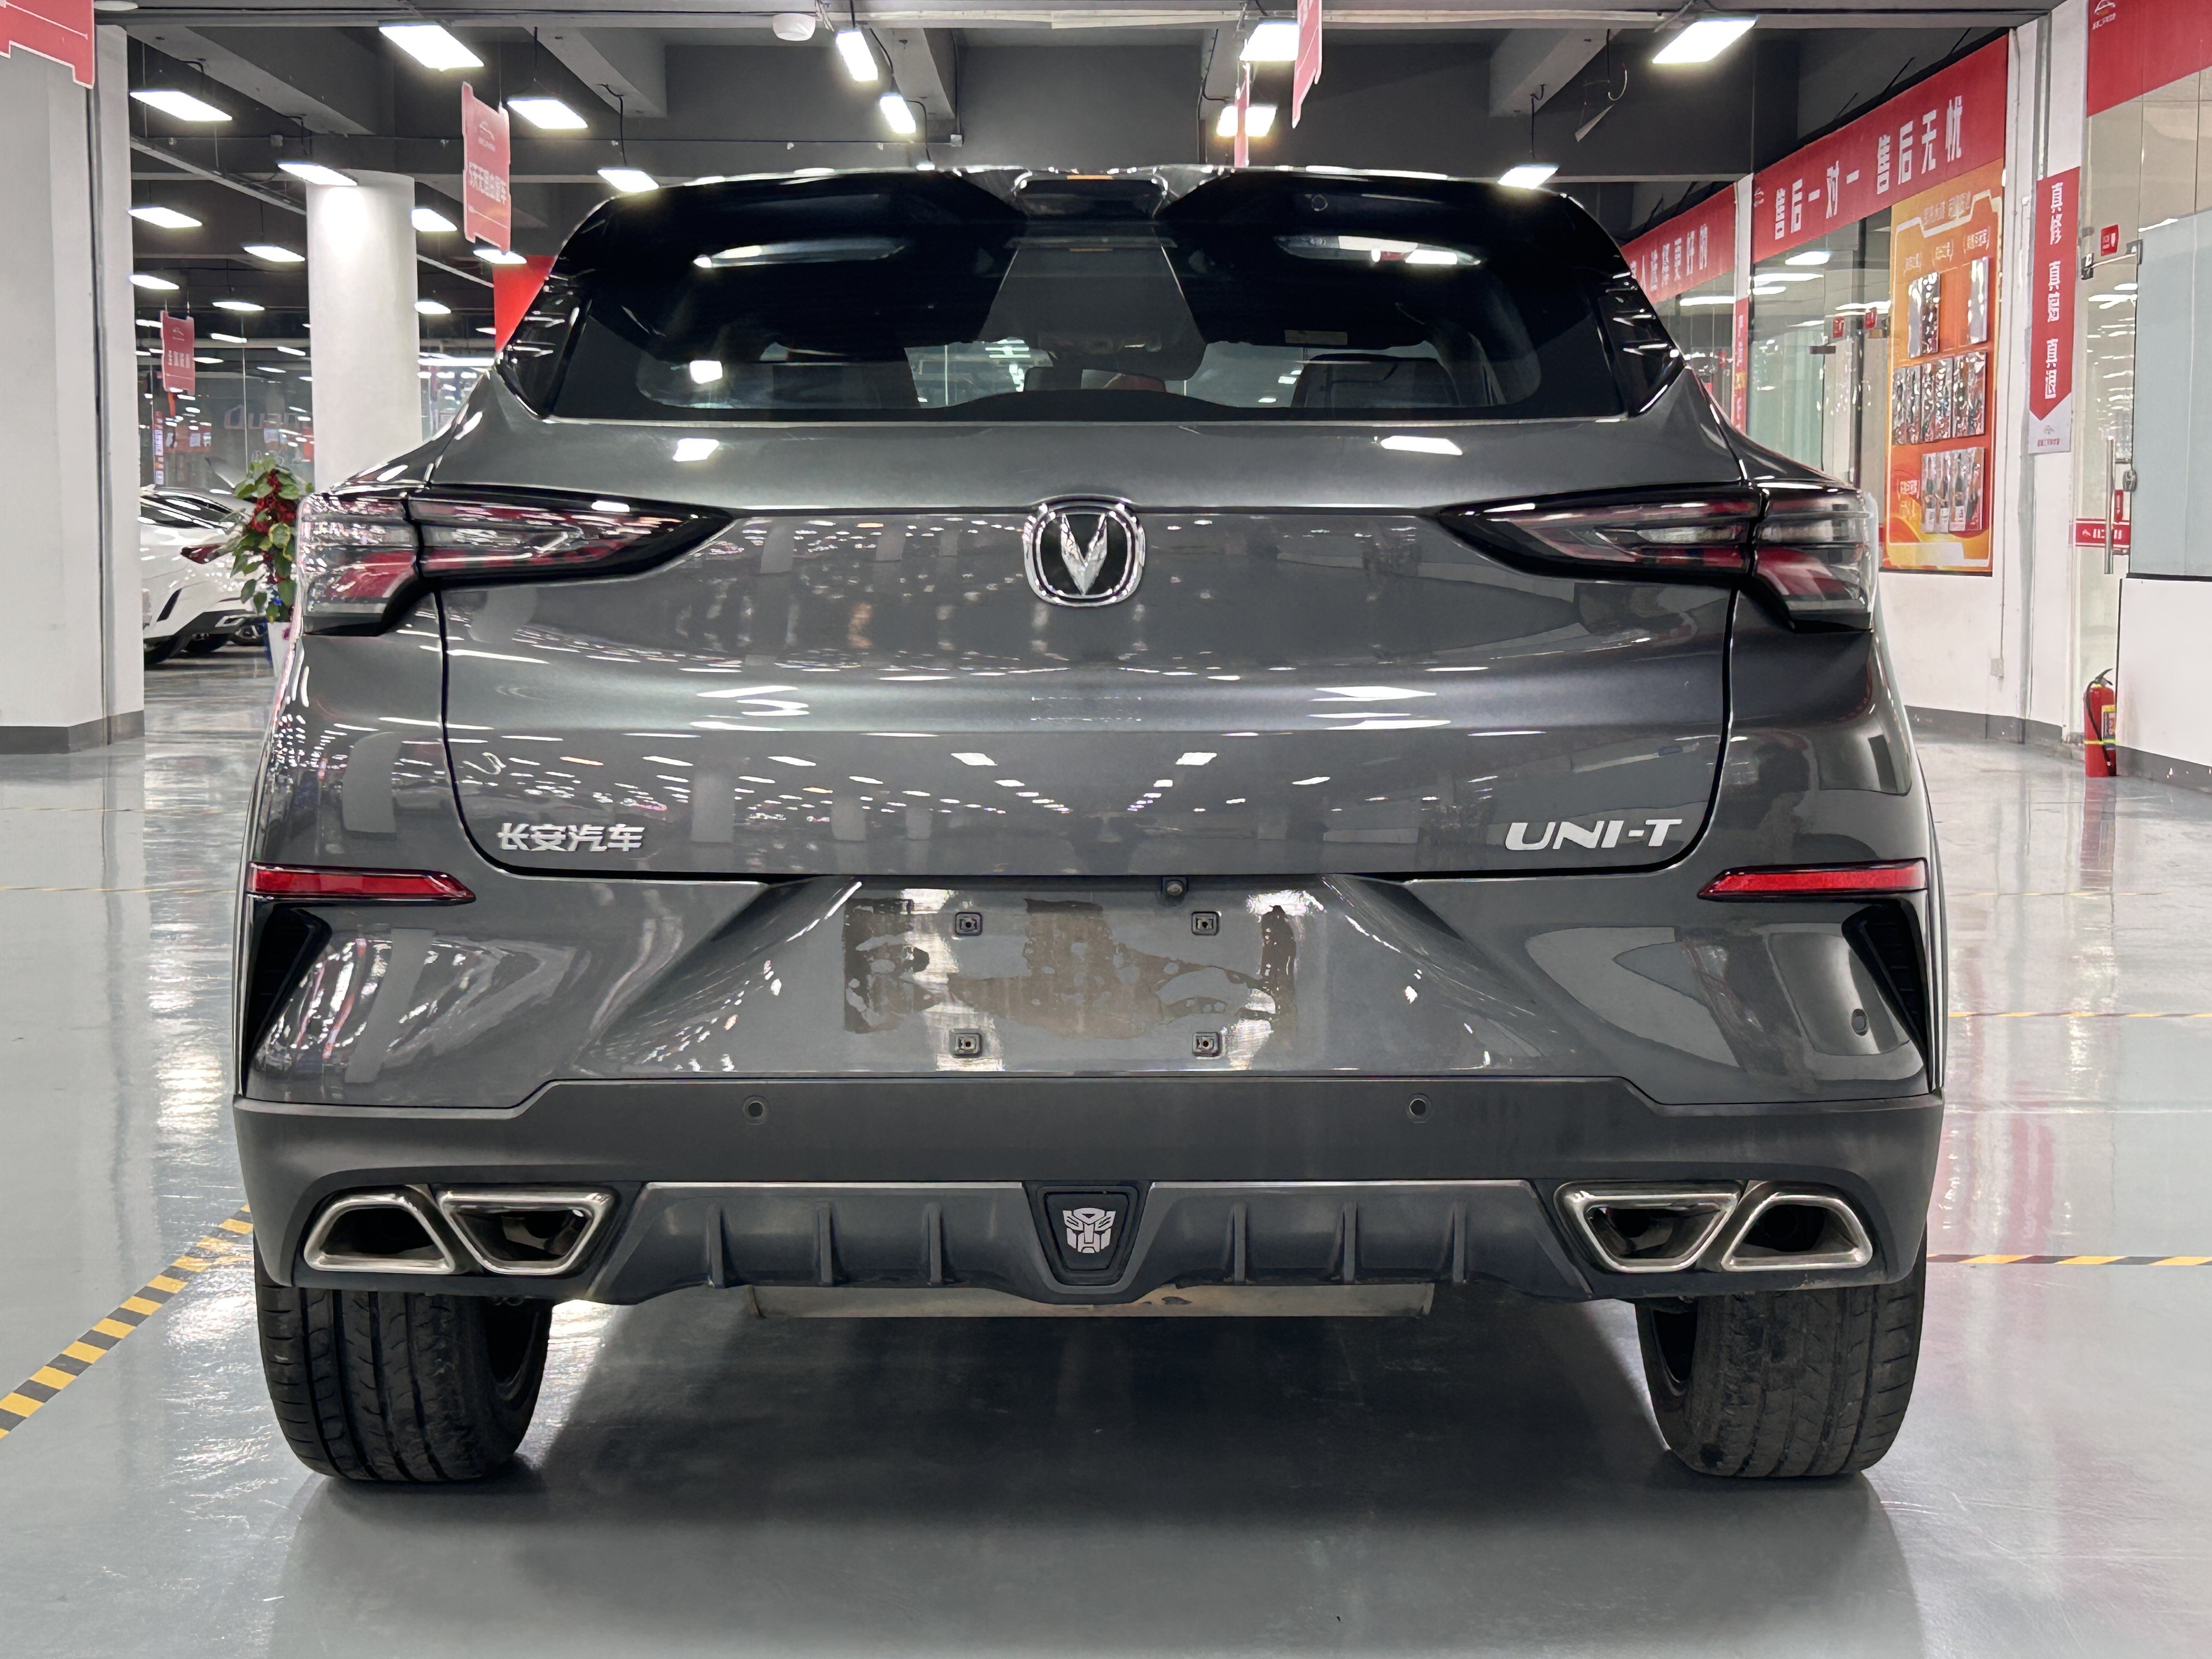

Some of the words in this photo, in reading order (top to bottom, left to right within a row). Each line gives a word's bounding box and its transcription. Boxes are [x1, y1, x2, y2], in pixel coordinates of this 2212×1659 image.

[1775, 160, 1860, 240] 售后一对一
[1876, 95, 1963, 195] 售后无忧
[496, 822, 645, 852] 长安汽车
[1505, 819, 1683, 850] UNI-T
